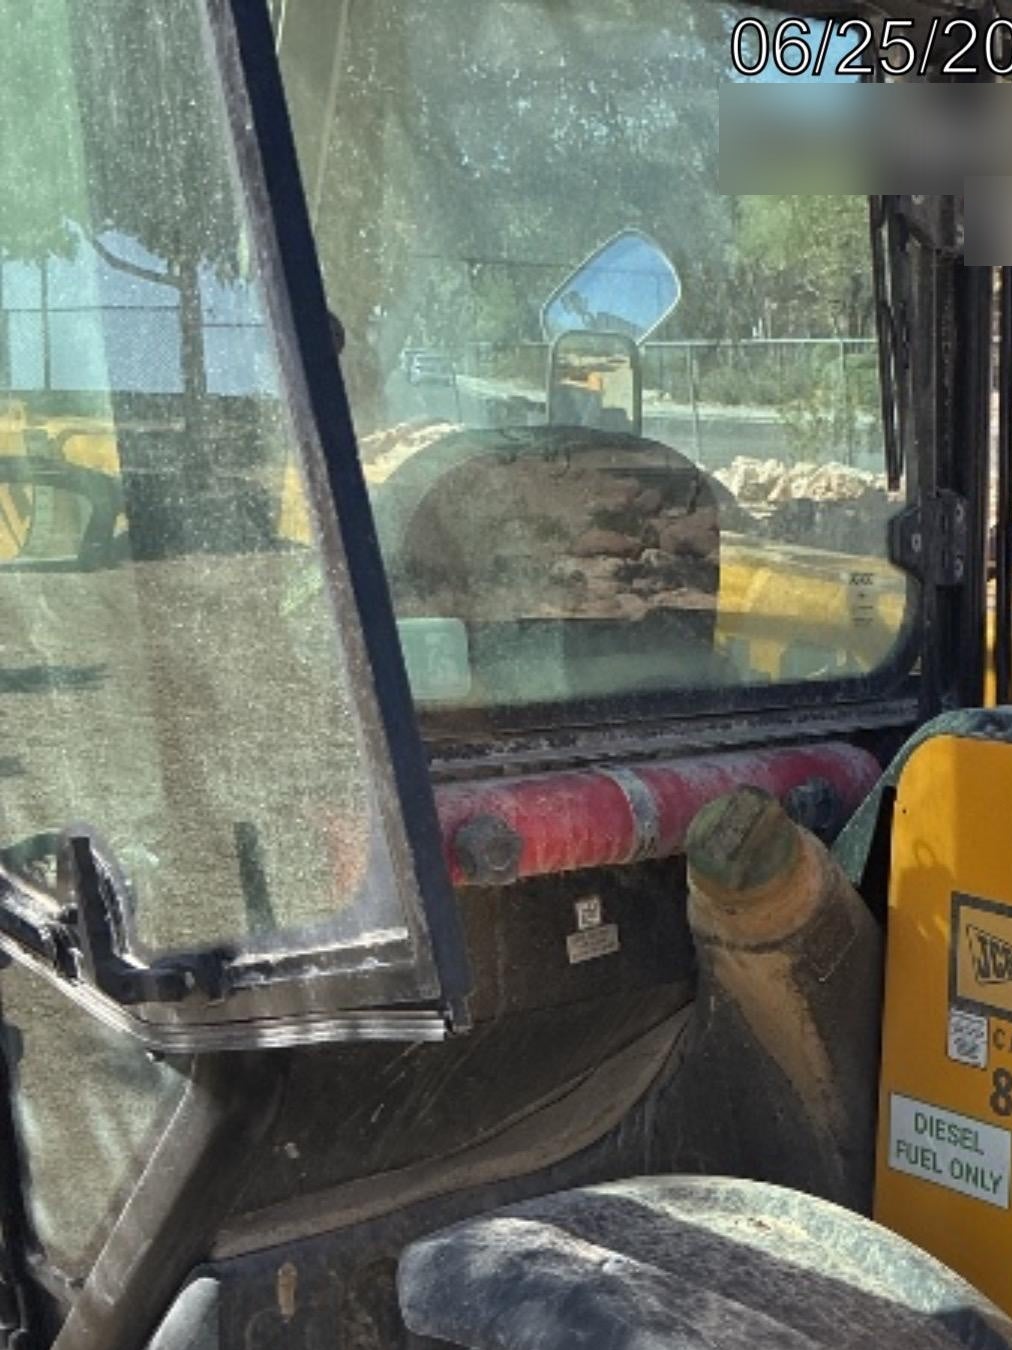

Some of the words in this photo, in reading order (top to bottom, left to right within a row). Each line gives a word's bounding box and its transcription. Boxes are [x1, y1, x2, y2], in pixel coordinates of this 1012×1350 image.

[913, 1111, 985, 1156] DIESEL
[896, 1139, 943, 1176] FUEL
[950, 1158, 1004, 1196] ONLY
